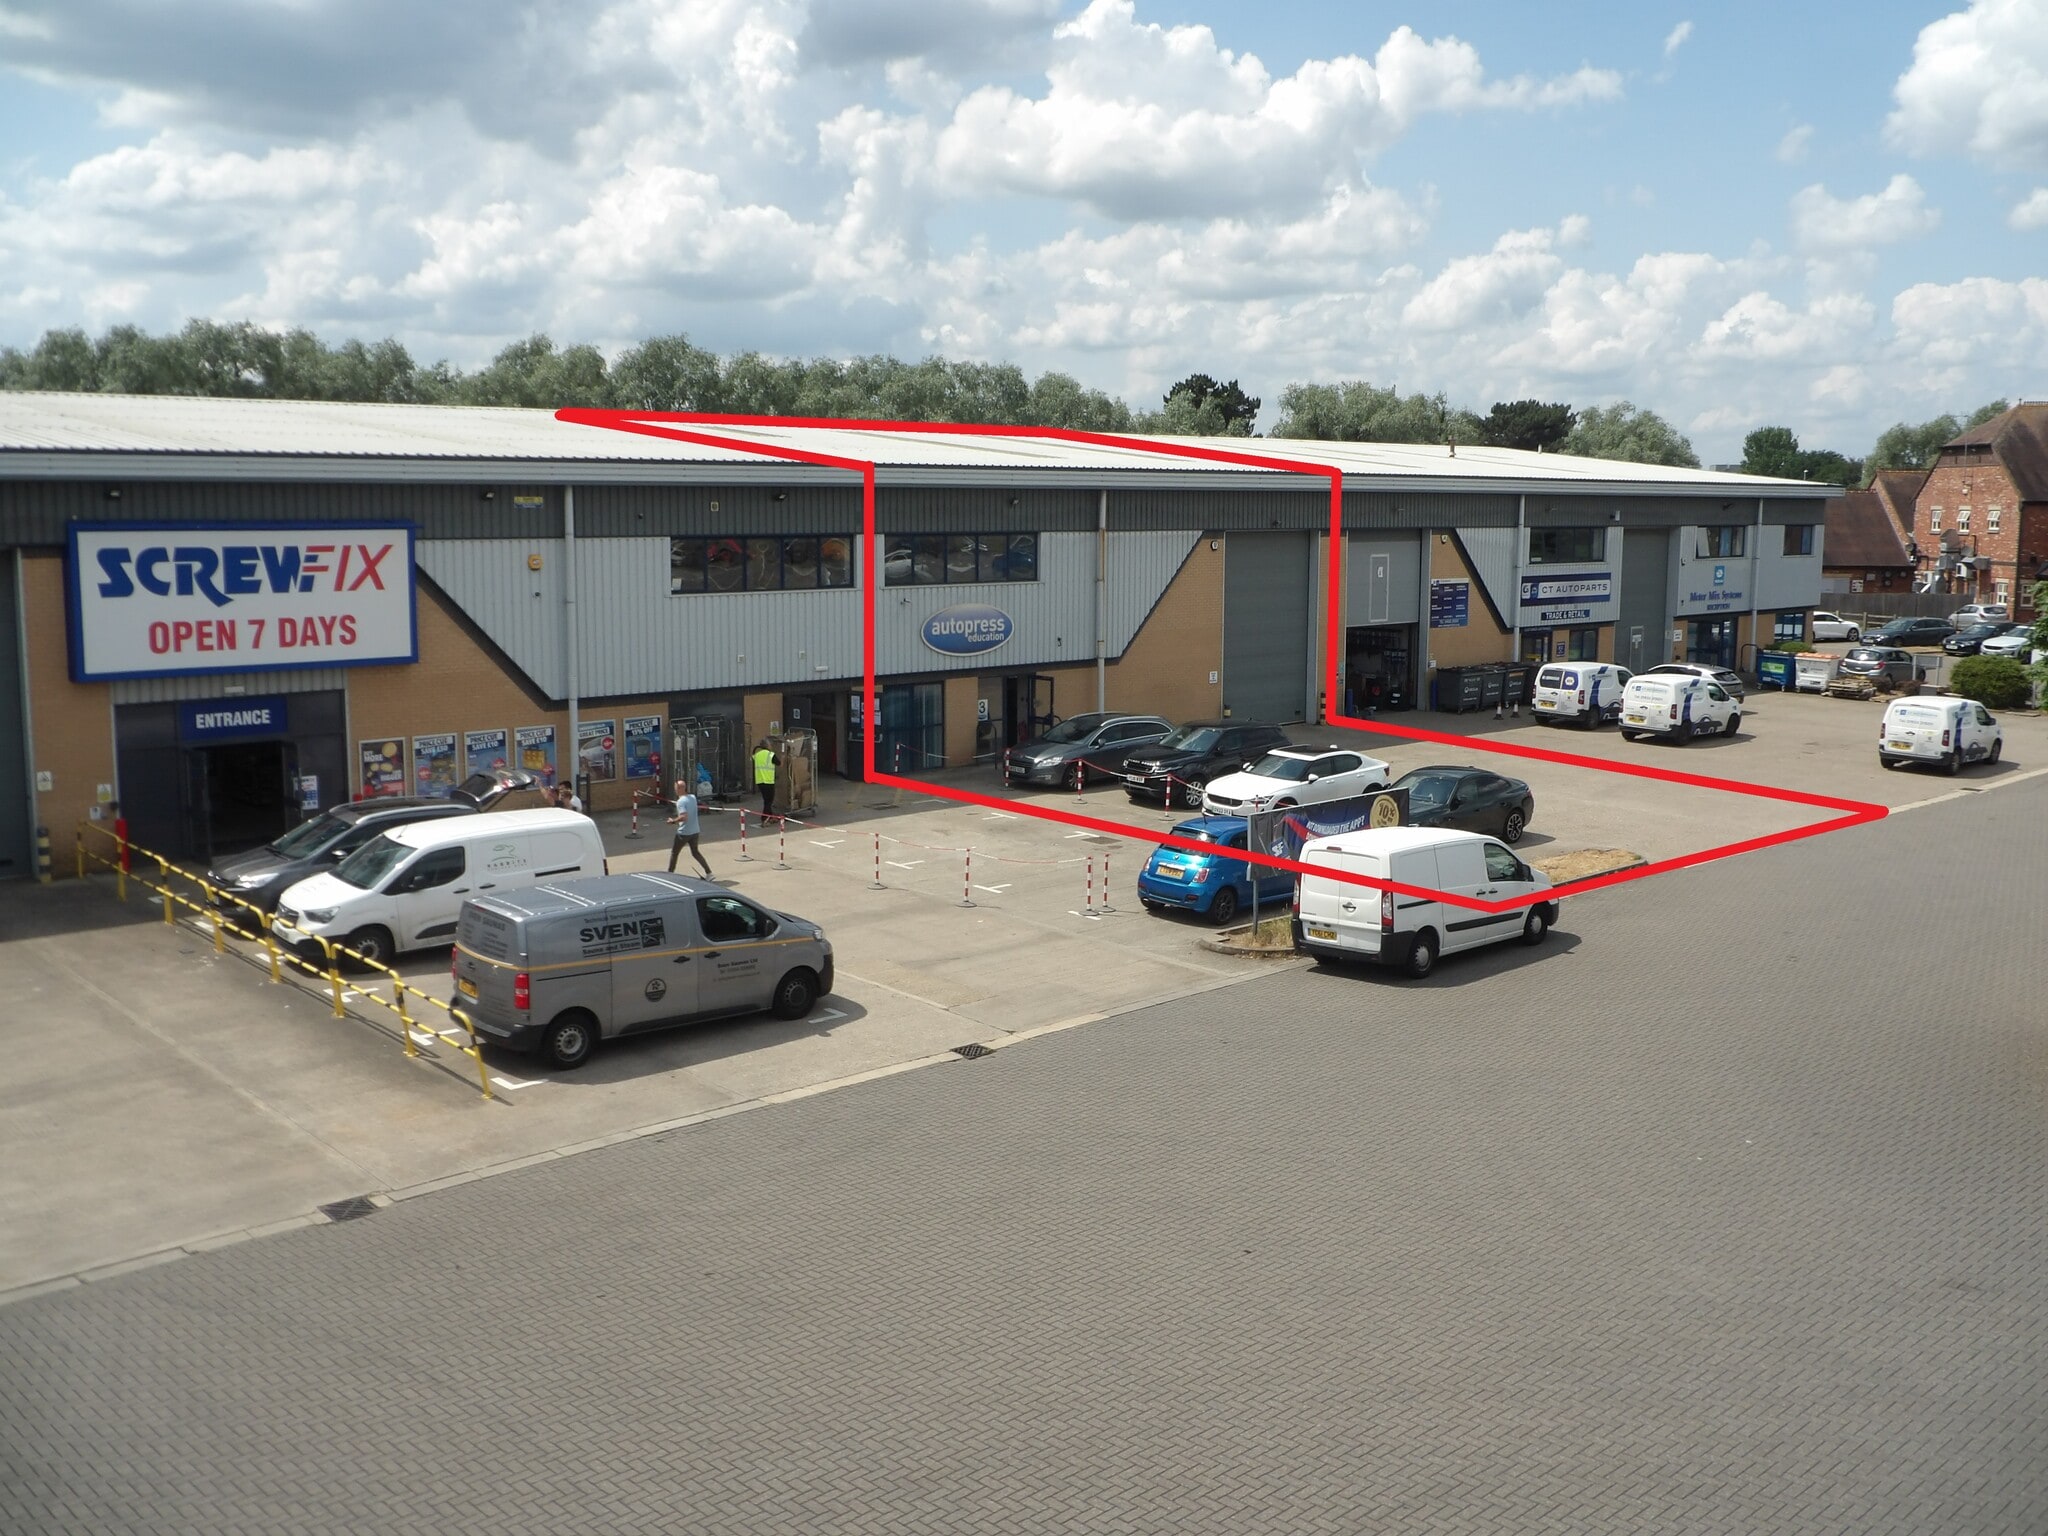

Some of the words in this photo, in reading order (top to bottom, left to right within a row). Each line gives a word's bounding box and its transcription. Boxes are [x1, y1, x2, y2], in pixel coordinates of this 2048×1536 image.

[97, 545, 394, 607] SCREWFIX
[1541, 586, 1554, 594] CT
[1556, 583, 1608, 593] AUTOPARTS
[1546, 611, 1562, 619] TRADE
[1568, 610, 1585, 618] RETAIL
[932, 618, 1005, 637] autopress
[149, 620, 237, 654] OPEN
[248, 618, 266, 649] 7
[278, 614, 357, 648] DAYS
[967, 632, 1004, 642] education
[979, 701, 986, 713] 3
[196, 709, 270, 729] ENTRANCE
[643, 719, 653, 727] CUT
[519, 732, 535, 740] PRICE
[418, 740, 435, 748] PRICE
[472, 743, 486, 751] SAVE
[521, 738, 535, 746] SAVE
[1378, 802, 1396, 819] 10%
[1350, 815, 1365, 830] APP?
[580, 921, 638, 942] SVEN
